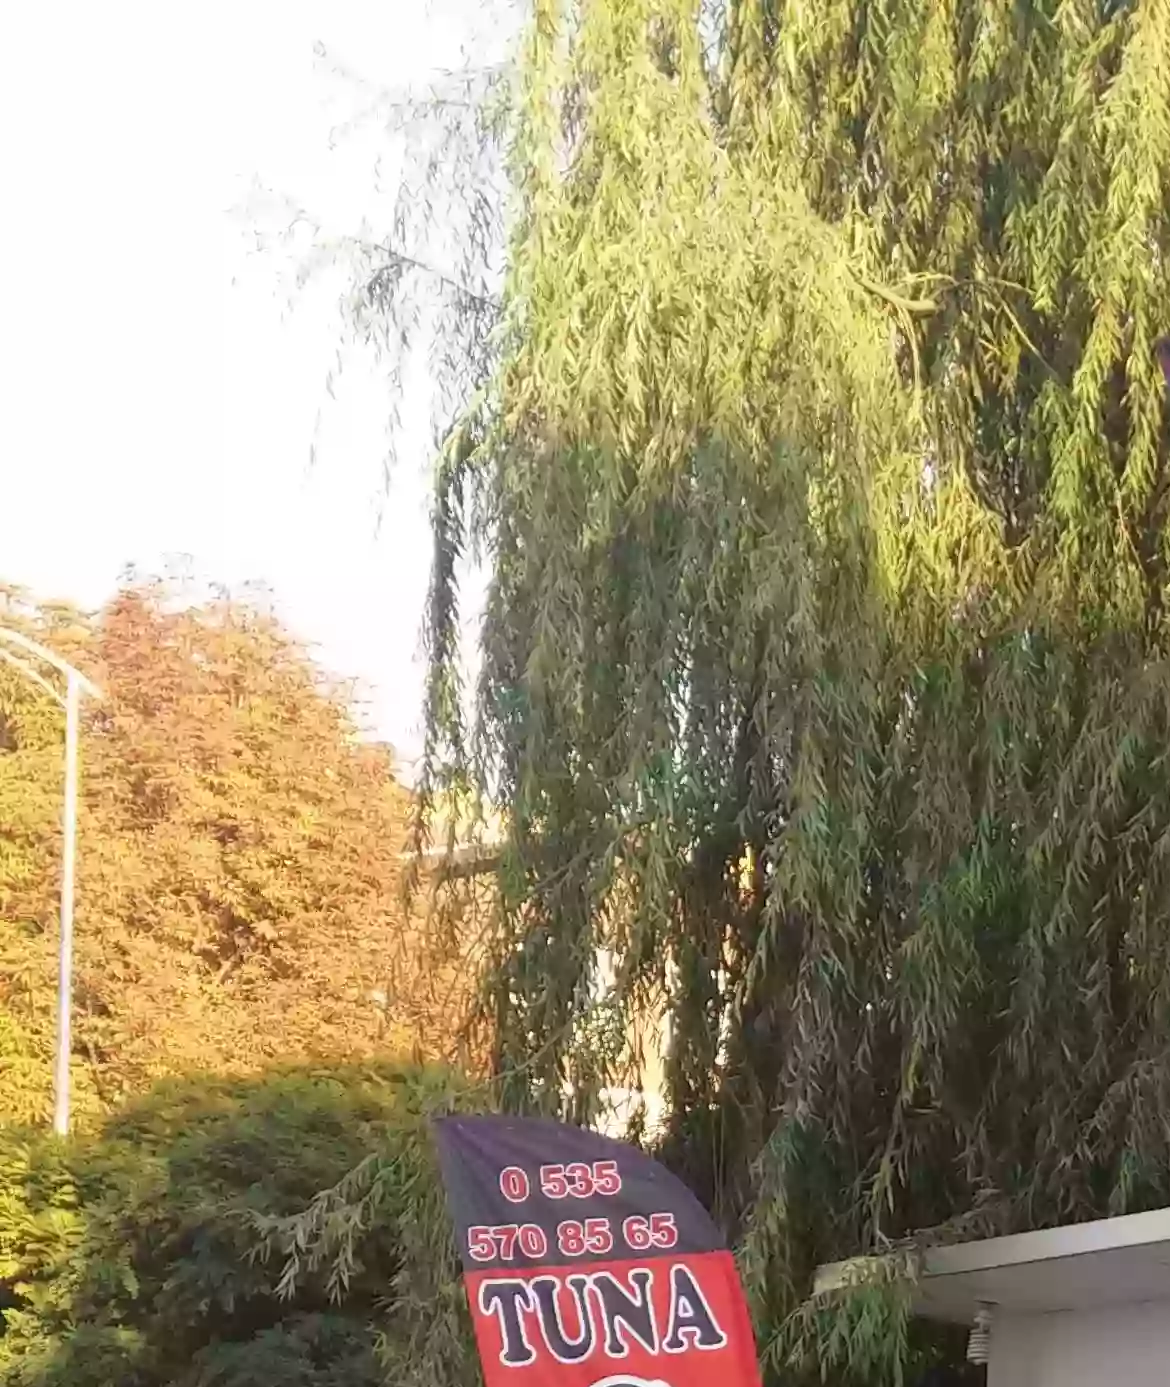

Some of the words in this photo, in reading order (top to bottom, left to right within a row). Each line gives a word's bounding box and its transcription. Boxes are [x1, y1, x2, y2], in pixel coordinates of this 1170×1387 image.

[500, 1166, 530, 1203] 0
[539, 1160, 622, 1199] 535
[467, 1223, 547, 1262] 570
[556, 1217, 614, 1257] 85
[623, 1212, 679, 1250] 65
[478, 1264, 728, 1368] TUNA
